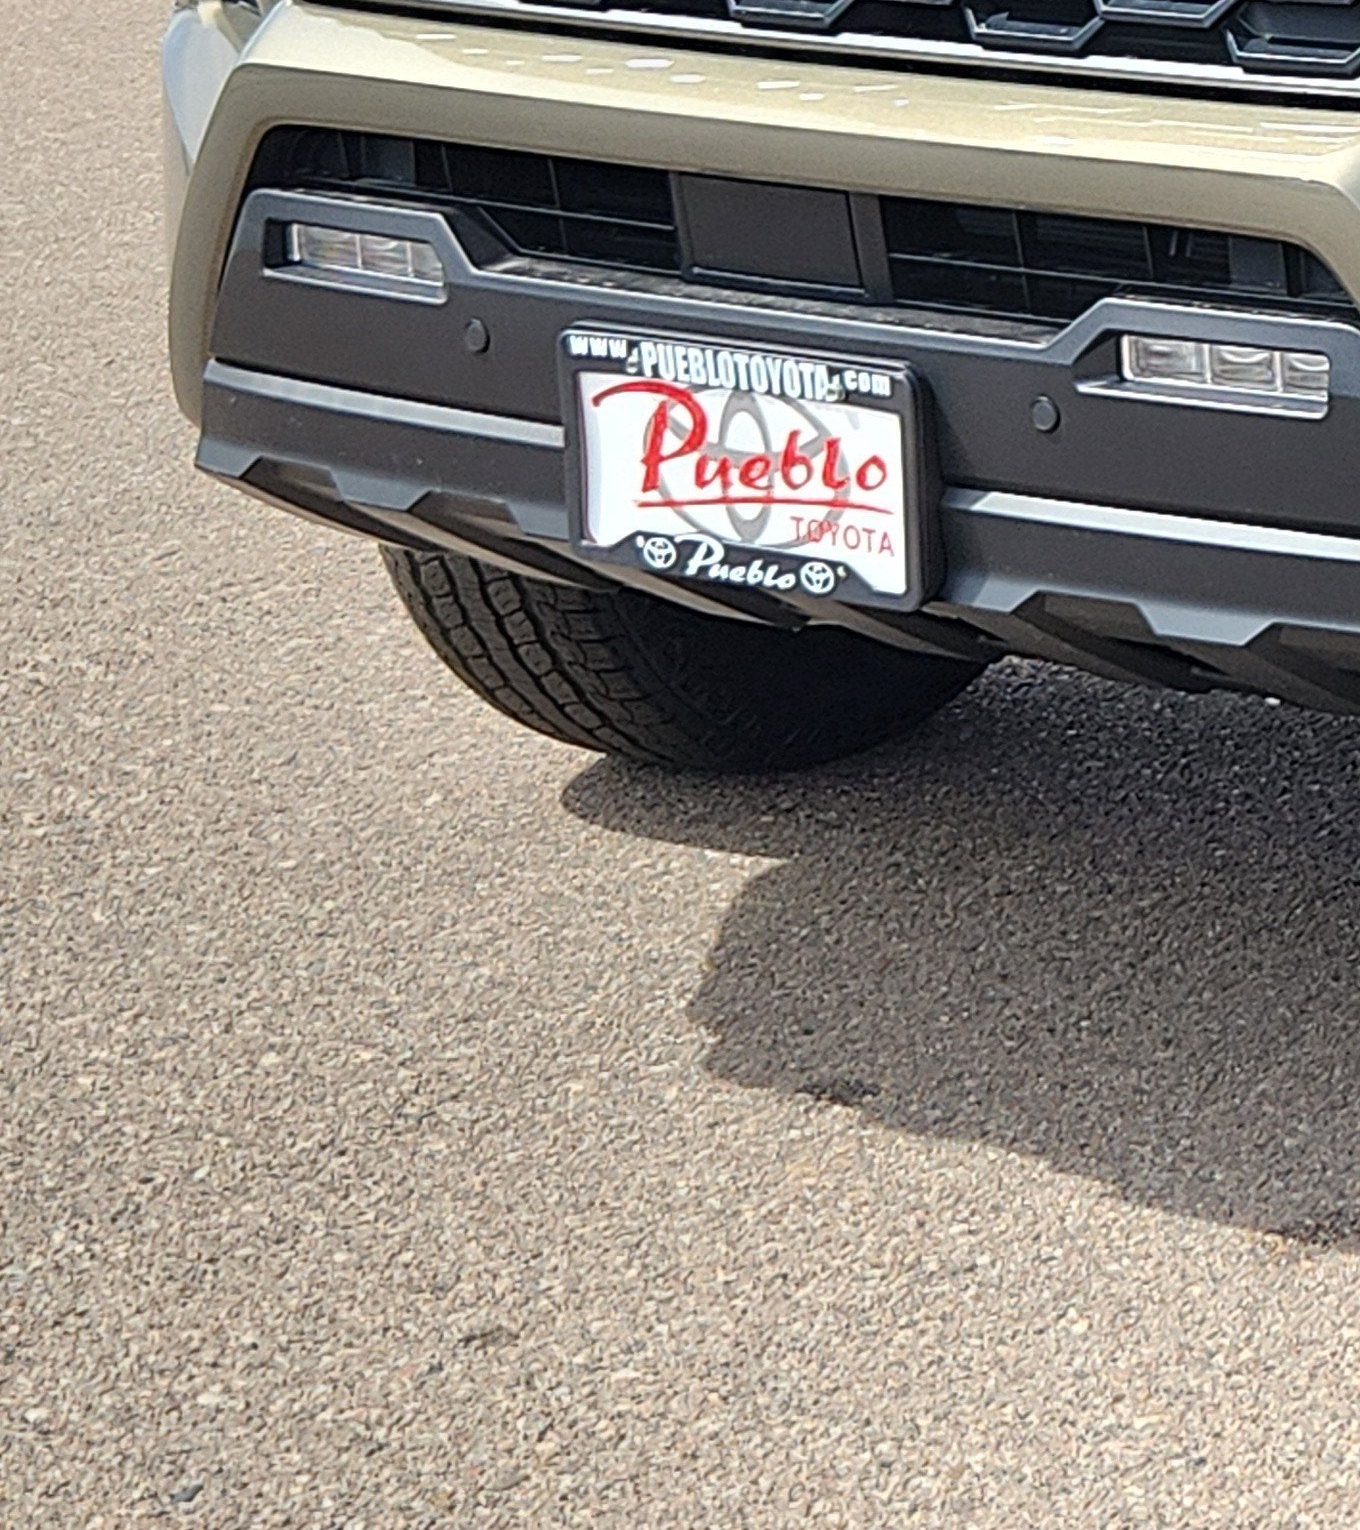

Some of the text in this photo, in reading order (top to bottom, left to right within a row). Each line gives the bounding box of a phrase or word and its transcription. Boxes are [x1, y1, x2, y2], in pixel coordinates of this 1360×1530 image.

[592, 380, 887, 493] Pueblo
[674, 532, 796, 590] Pueblo
[789, 515, 896, 557] TOYOTA
